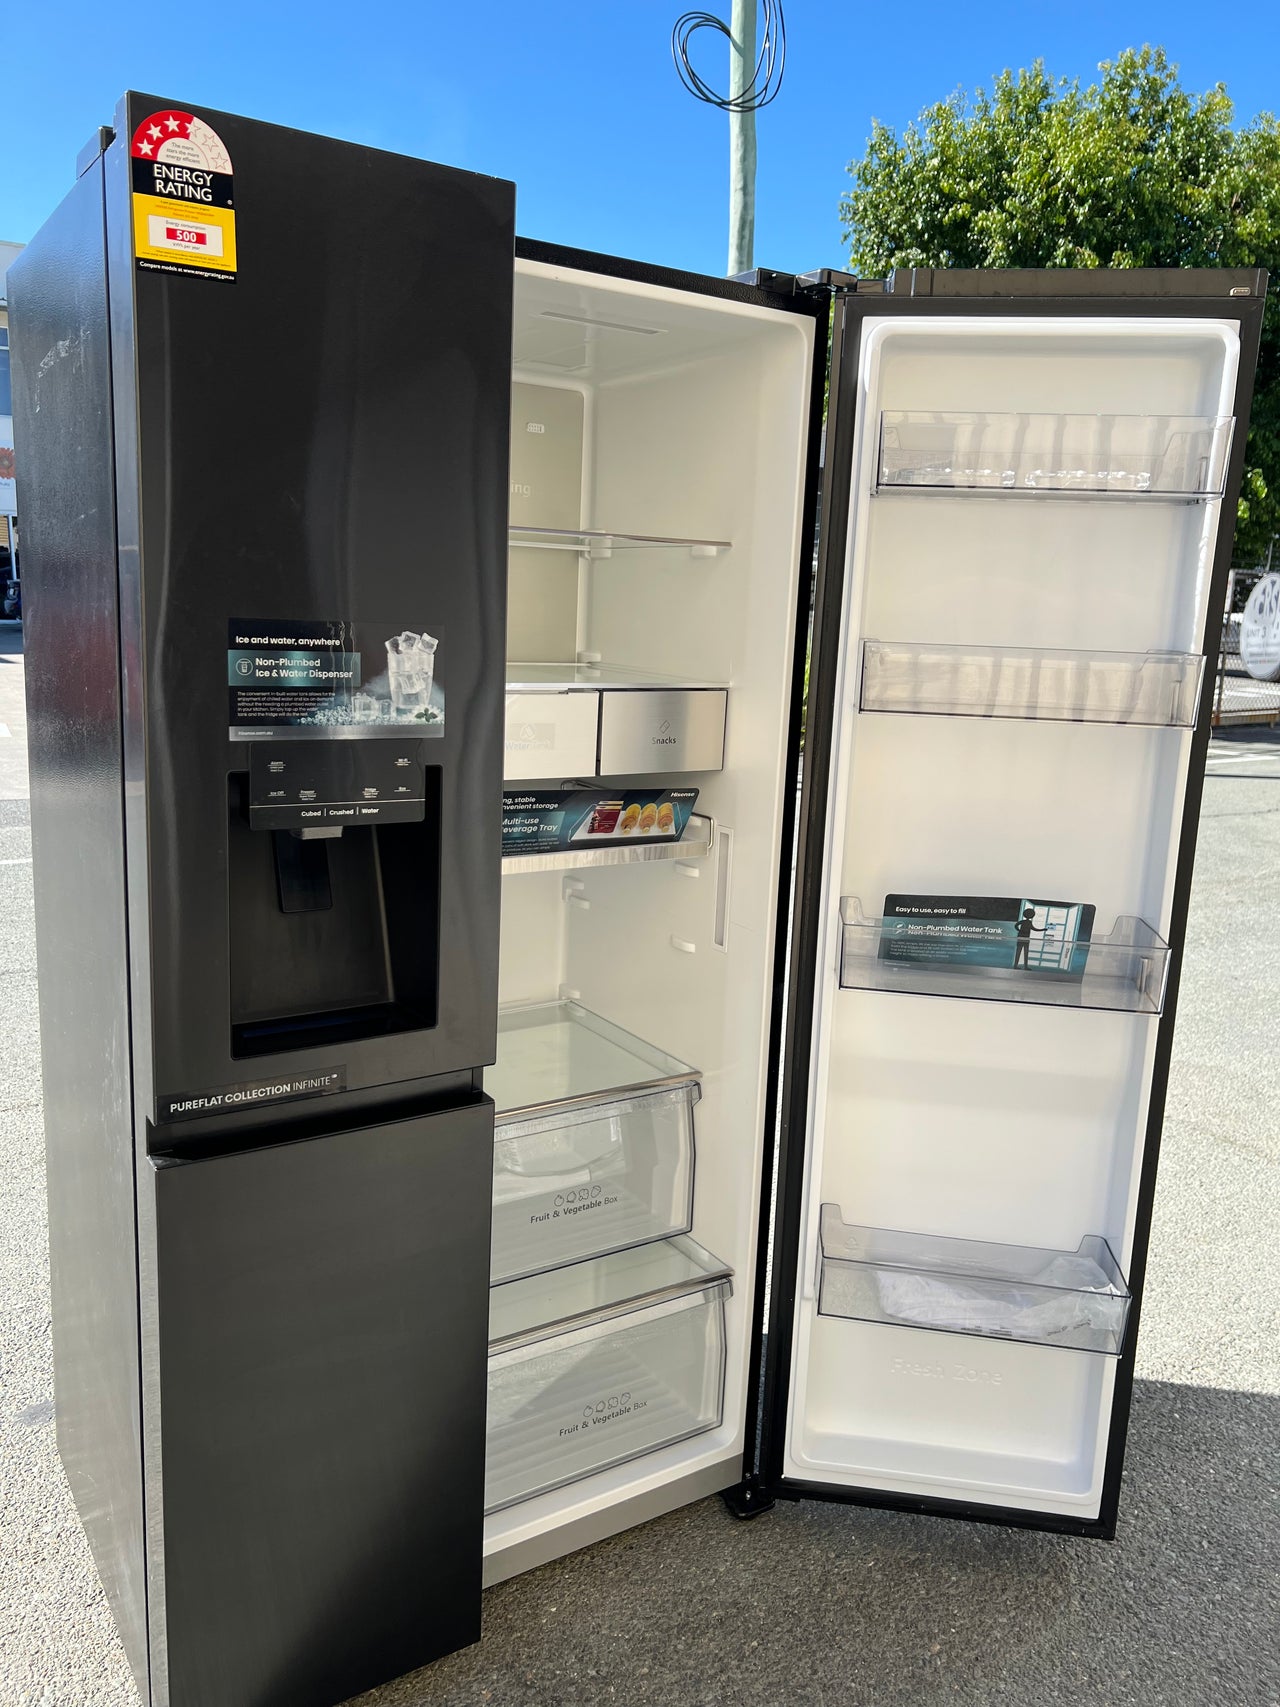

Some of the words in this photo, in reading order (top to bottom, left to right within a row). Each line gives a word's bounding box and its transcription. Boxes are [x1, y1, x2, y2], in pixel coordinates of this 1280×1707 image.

[154, 163, 213, 187] ENERGY
[156, 179, 213, 201] RATING
[176, 230, 197, 242] 500
[140, 261, 160, 269] Compare
[269, 637, 298, 646] water,
[298, 638, 340, 647] anywhere
[255, 658, 320, 666] Non-Plumbed
[309, 670, 353, 679] Dispenser
[652, 736, 677, 744] Snacks
[170, 1095, 223, 1113] PUREFLAT
[225, 1083, 291, 1103] COLLECTION
[293, 1076, 330, 1091] INFINITE
[530, 1213, 550, 1223] Fruit
[563, 1200, 601, 1215] Vegetable
[604, 1196, 618, 1204] Box
[952, 1364, 1002, 1385] Zone
[560, 1424, 578, 1436] Fruit
[581, 1421, 589, 1429] &
[592, 1406, 631, 1424] Vegetable
[634, 1401, 648, 1410] Box
